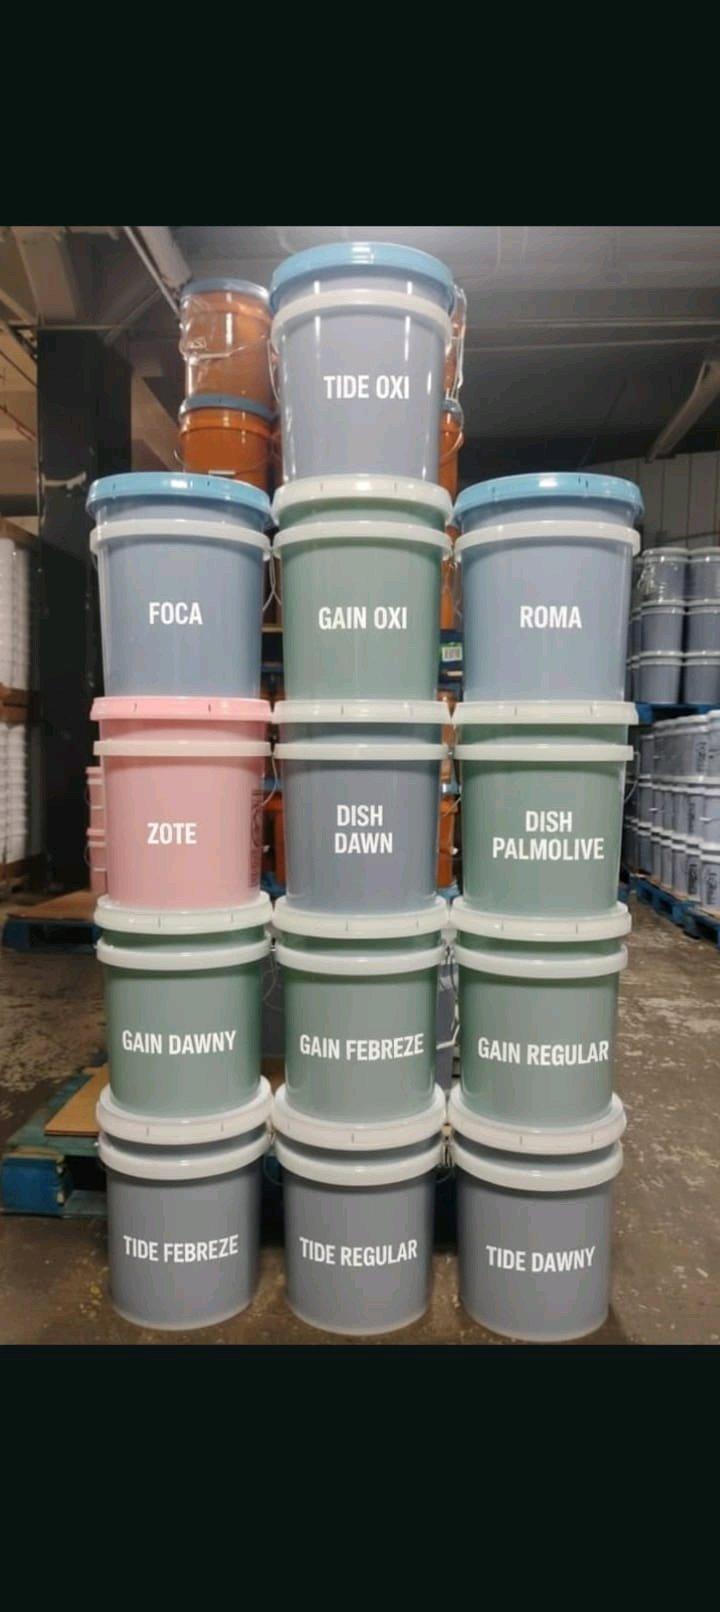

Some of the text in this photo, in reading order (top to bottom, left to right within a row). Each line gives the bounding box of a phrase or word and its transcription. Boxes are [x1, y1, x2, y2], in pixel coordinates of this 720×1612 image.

[324, 375, 409, 399] TIDE OXI
[150, 602, 202, 624] FOCA
[319, 607, 409, 629] GAIN OXI
[521, 606, 582, 628] ROMA
[337, 805, 382, 826] DISH
[526, 811, 572, 832] DISH
[148, 823, 196, 844] ZOTE
[335, 832, 392, 853] DAWN
[493, 837, 604, 860] PALMOLIVE
[123, 1030, 235, 1054] GAIN DAWNY
[301, 1034, 423, 1060] GAIN FEBREZE
[479, 1038, 608, 1066] GAIN REGULAR
[124, 1235, 238, 1262] TIDE FEBREZE
[300, 1237, 417, 1266] TIDE REGULAR
[486, 1246, 595, 1272] TIDE DAWNY
